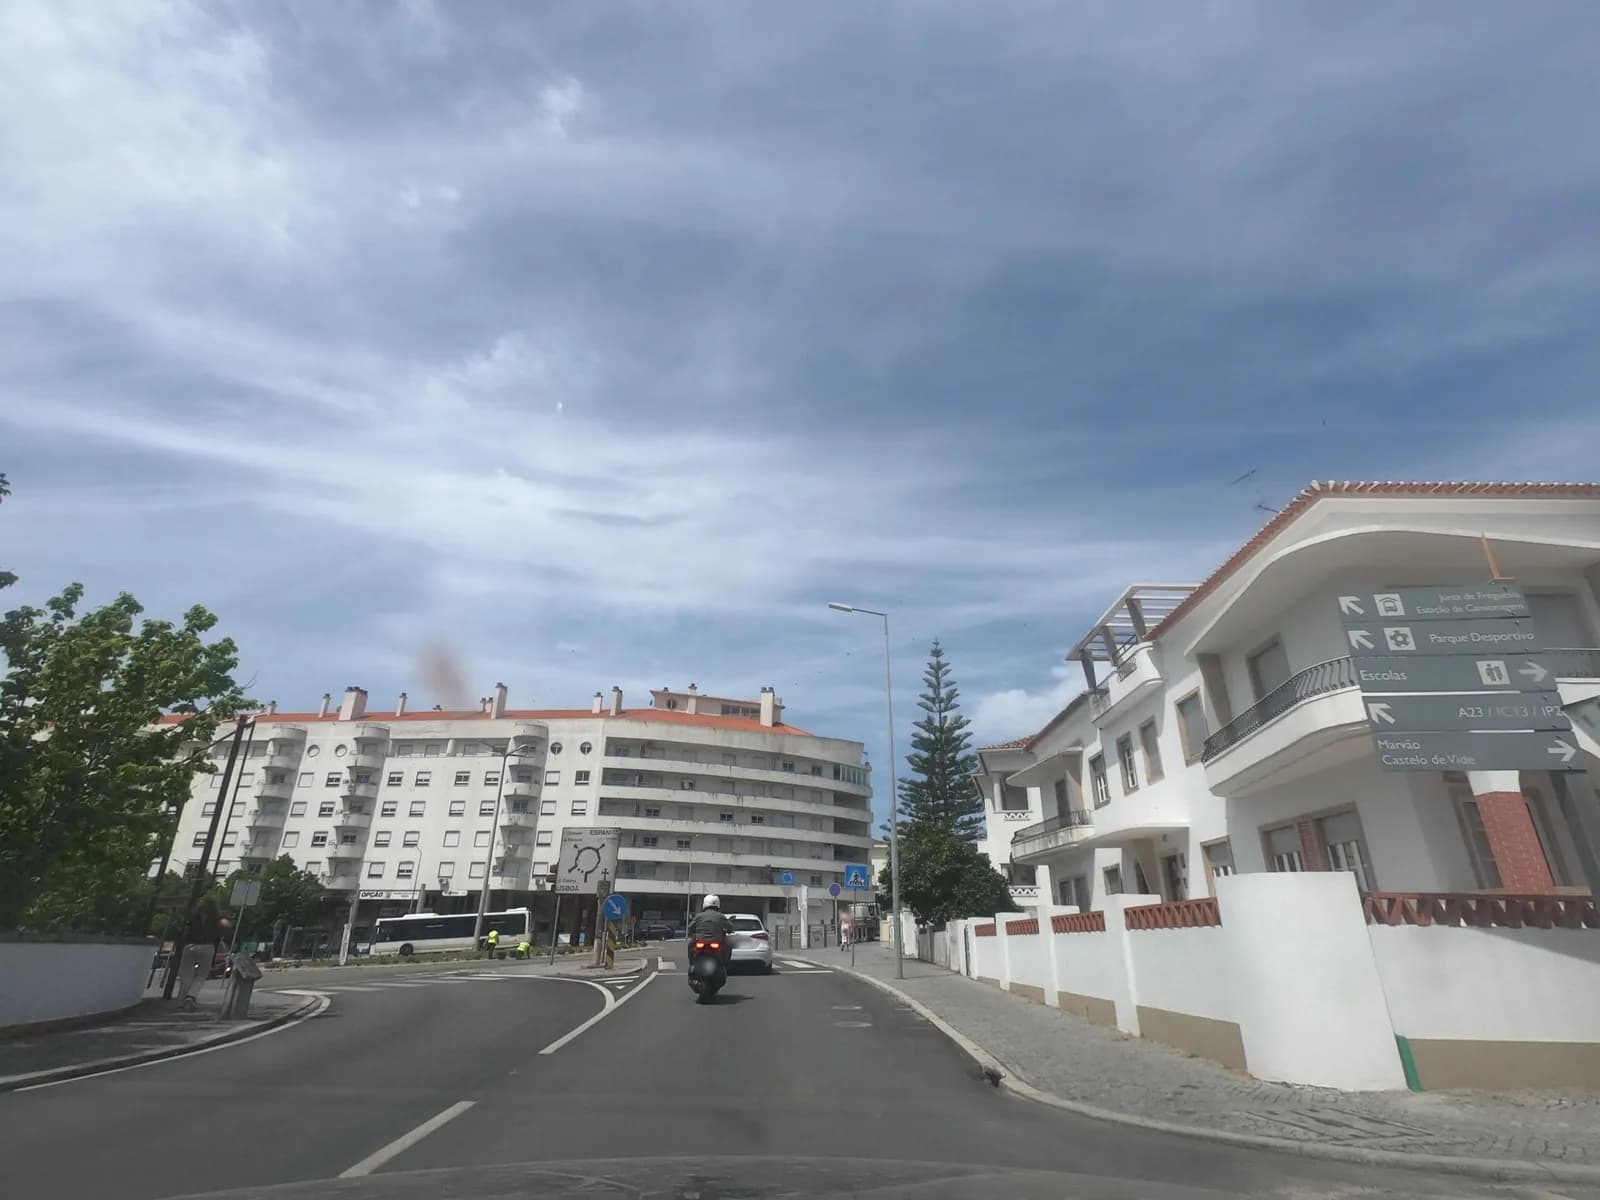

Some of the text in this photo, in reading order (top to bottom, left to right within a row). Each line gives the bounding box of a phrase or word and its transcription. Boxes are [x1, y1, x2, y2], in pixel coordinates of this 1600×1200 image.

[1430, 631, 1535, 645] Parque Desportivo
[1360, 669, 1408, 681] Escolas
[1458, 706, 1484, 718] A23
[1541, 705, 1562, 717] IP2
[1377, 739, 1421, 750] Marvão
[1382, 754, 1477, 766] Castelo de Vide
